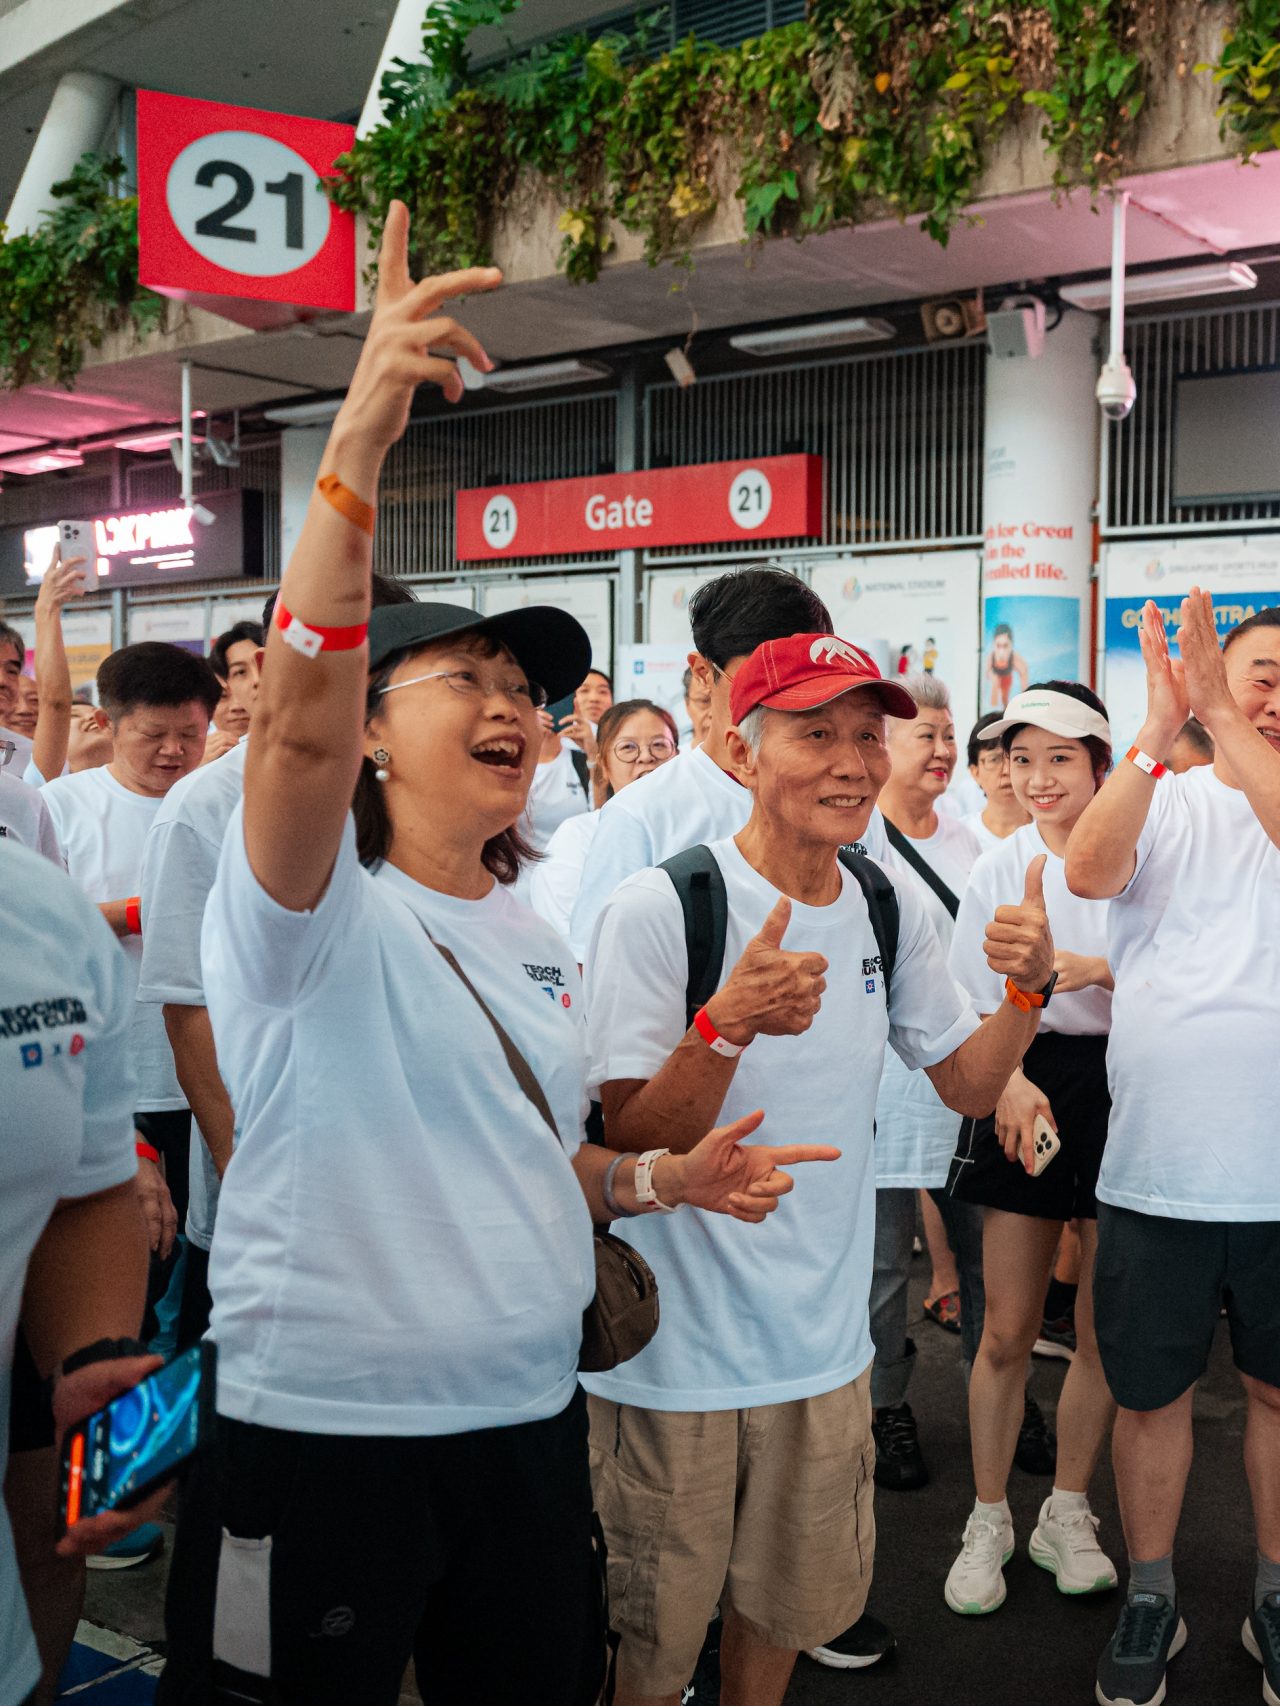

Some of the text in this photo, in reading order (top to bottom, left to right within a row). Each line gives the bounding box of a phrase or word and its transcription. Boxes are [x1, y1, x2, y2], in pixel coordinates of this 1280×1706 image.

[194, 160, 304, 251] 21
[489, 485, 764, 534] 21 Gate 21
[1022, 521, 1073, 539] Great
[1001, 542, 1025, 559] the
[1035, 561, 1068, 581] life.
[1213, 604, 1257, 625] XTRA
[522, 962, 563, 977] TEOCH
[0, 996, 83, 1021] EOCHEW
